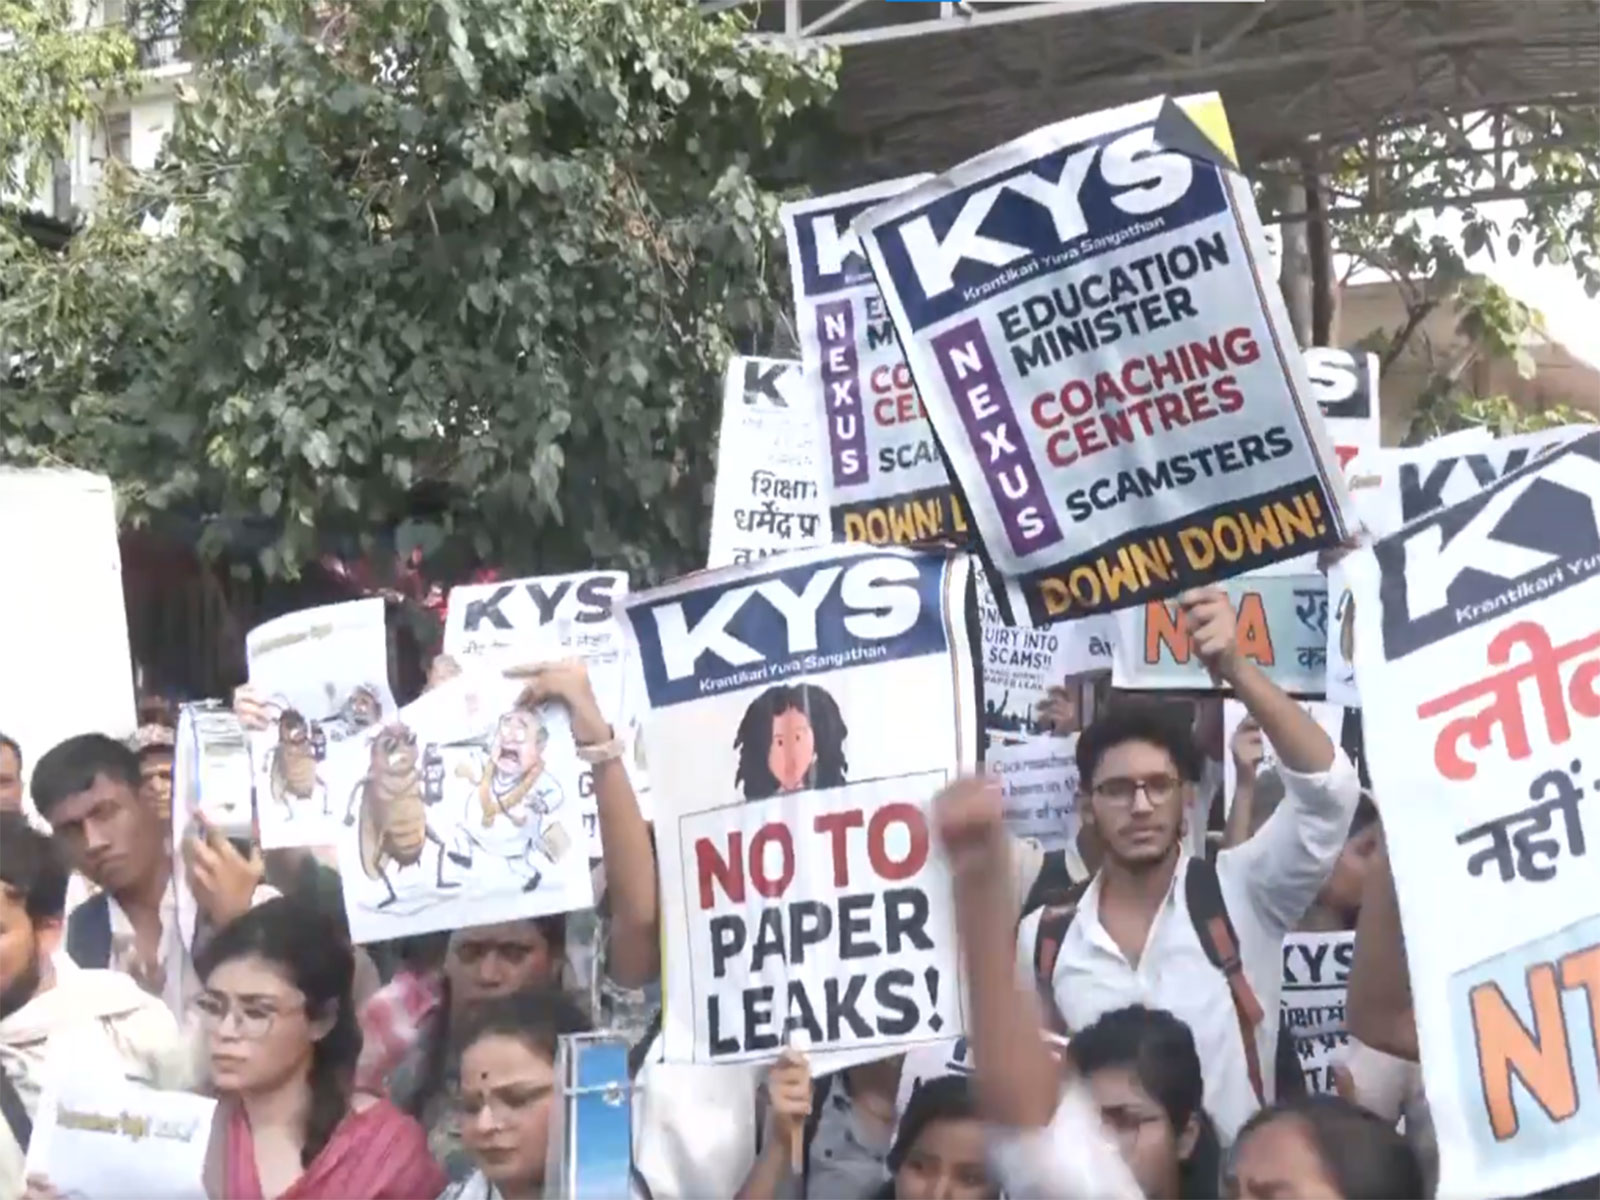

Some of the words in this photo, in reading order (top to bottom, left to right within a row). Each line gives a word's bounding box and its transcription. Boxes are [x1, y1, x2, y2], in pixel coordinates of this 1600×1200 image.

[898, 126, 1194, 299] KYS
[963, 260, 1040, 301] Krantikari
[1080, 216, 1166, 252] Sangathan
[997, 232, 1231, 343] EDUCATION
[1010, 287, 1198, 378] MINISTER
[823, 312, 861, 475] NEXUS
[1030, 326, 1261, 430] COACHING
[1046, 375, 1245, 468] CENTRES
[948, 340, 1046, 540] NEXUS
[1065, 427, 1294, 521] SCAMSTERS
[1399, 440, 1566, 524] KY
[844, 496, 943, 547] DOWN!
[1039, 548, 1176, 617] DOWN!
[1181, 492, 1325, 571] DOWN!
[464, 576, 617, 631] KYS
[653, 557, 921, 681] KYS
[1145, 593, 1275, 666] NA
[1456, 567, 1564, 624] Krantikari
[803, 645, 887, 670] Sangathan
[1024, 632, 1058, 652] INTO
[695, 822, 795, 909] NO
[814, 803, 930, 888] TO
[1456, 758, 1586, 882] नहीं
[709, 887, 935, 979] PAPER
[708, 966, 944, 1057] LEAKS!
